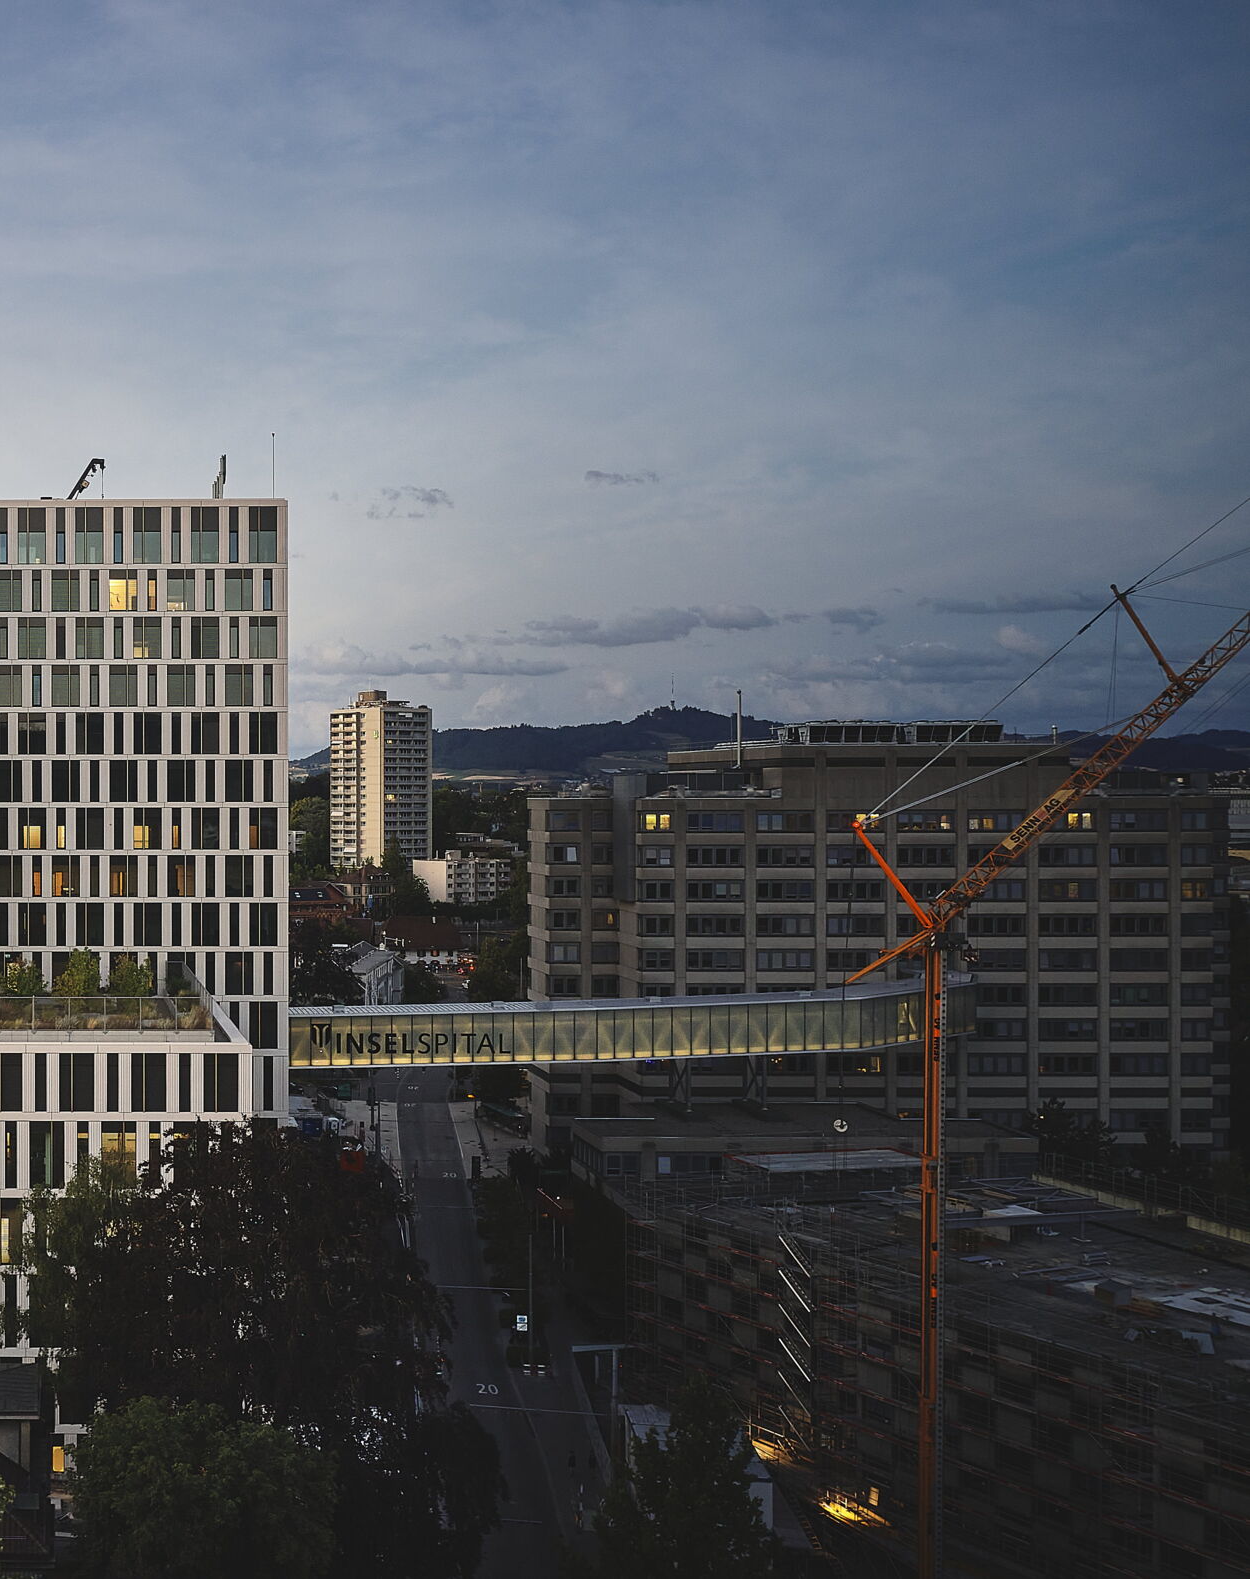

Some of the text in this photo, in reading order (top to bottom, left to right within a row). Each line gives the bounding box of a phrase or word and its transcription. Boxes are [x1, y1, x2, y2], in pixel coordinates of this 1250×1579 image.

[1010, 798, 1061, 843] SENN AG
[336, 1032, 511, 1054] INSELSPITAL
[476, 1383, 499, 1395] 20
